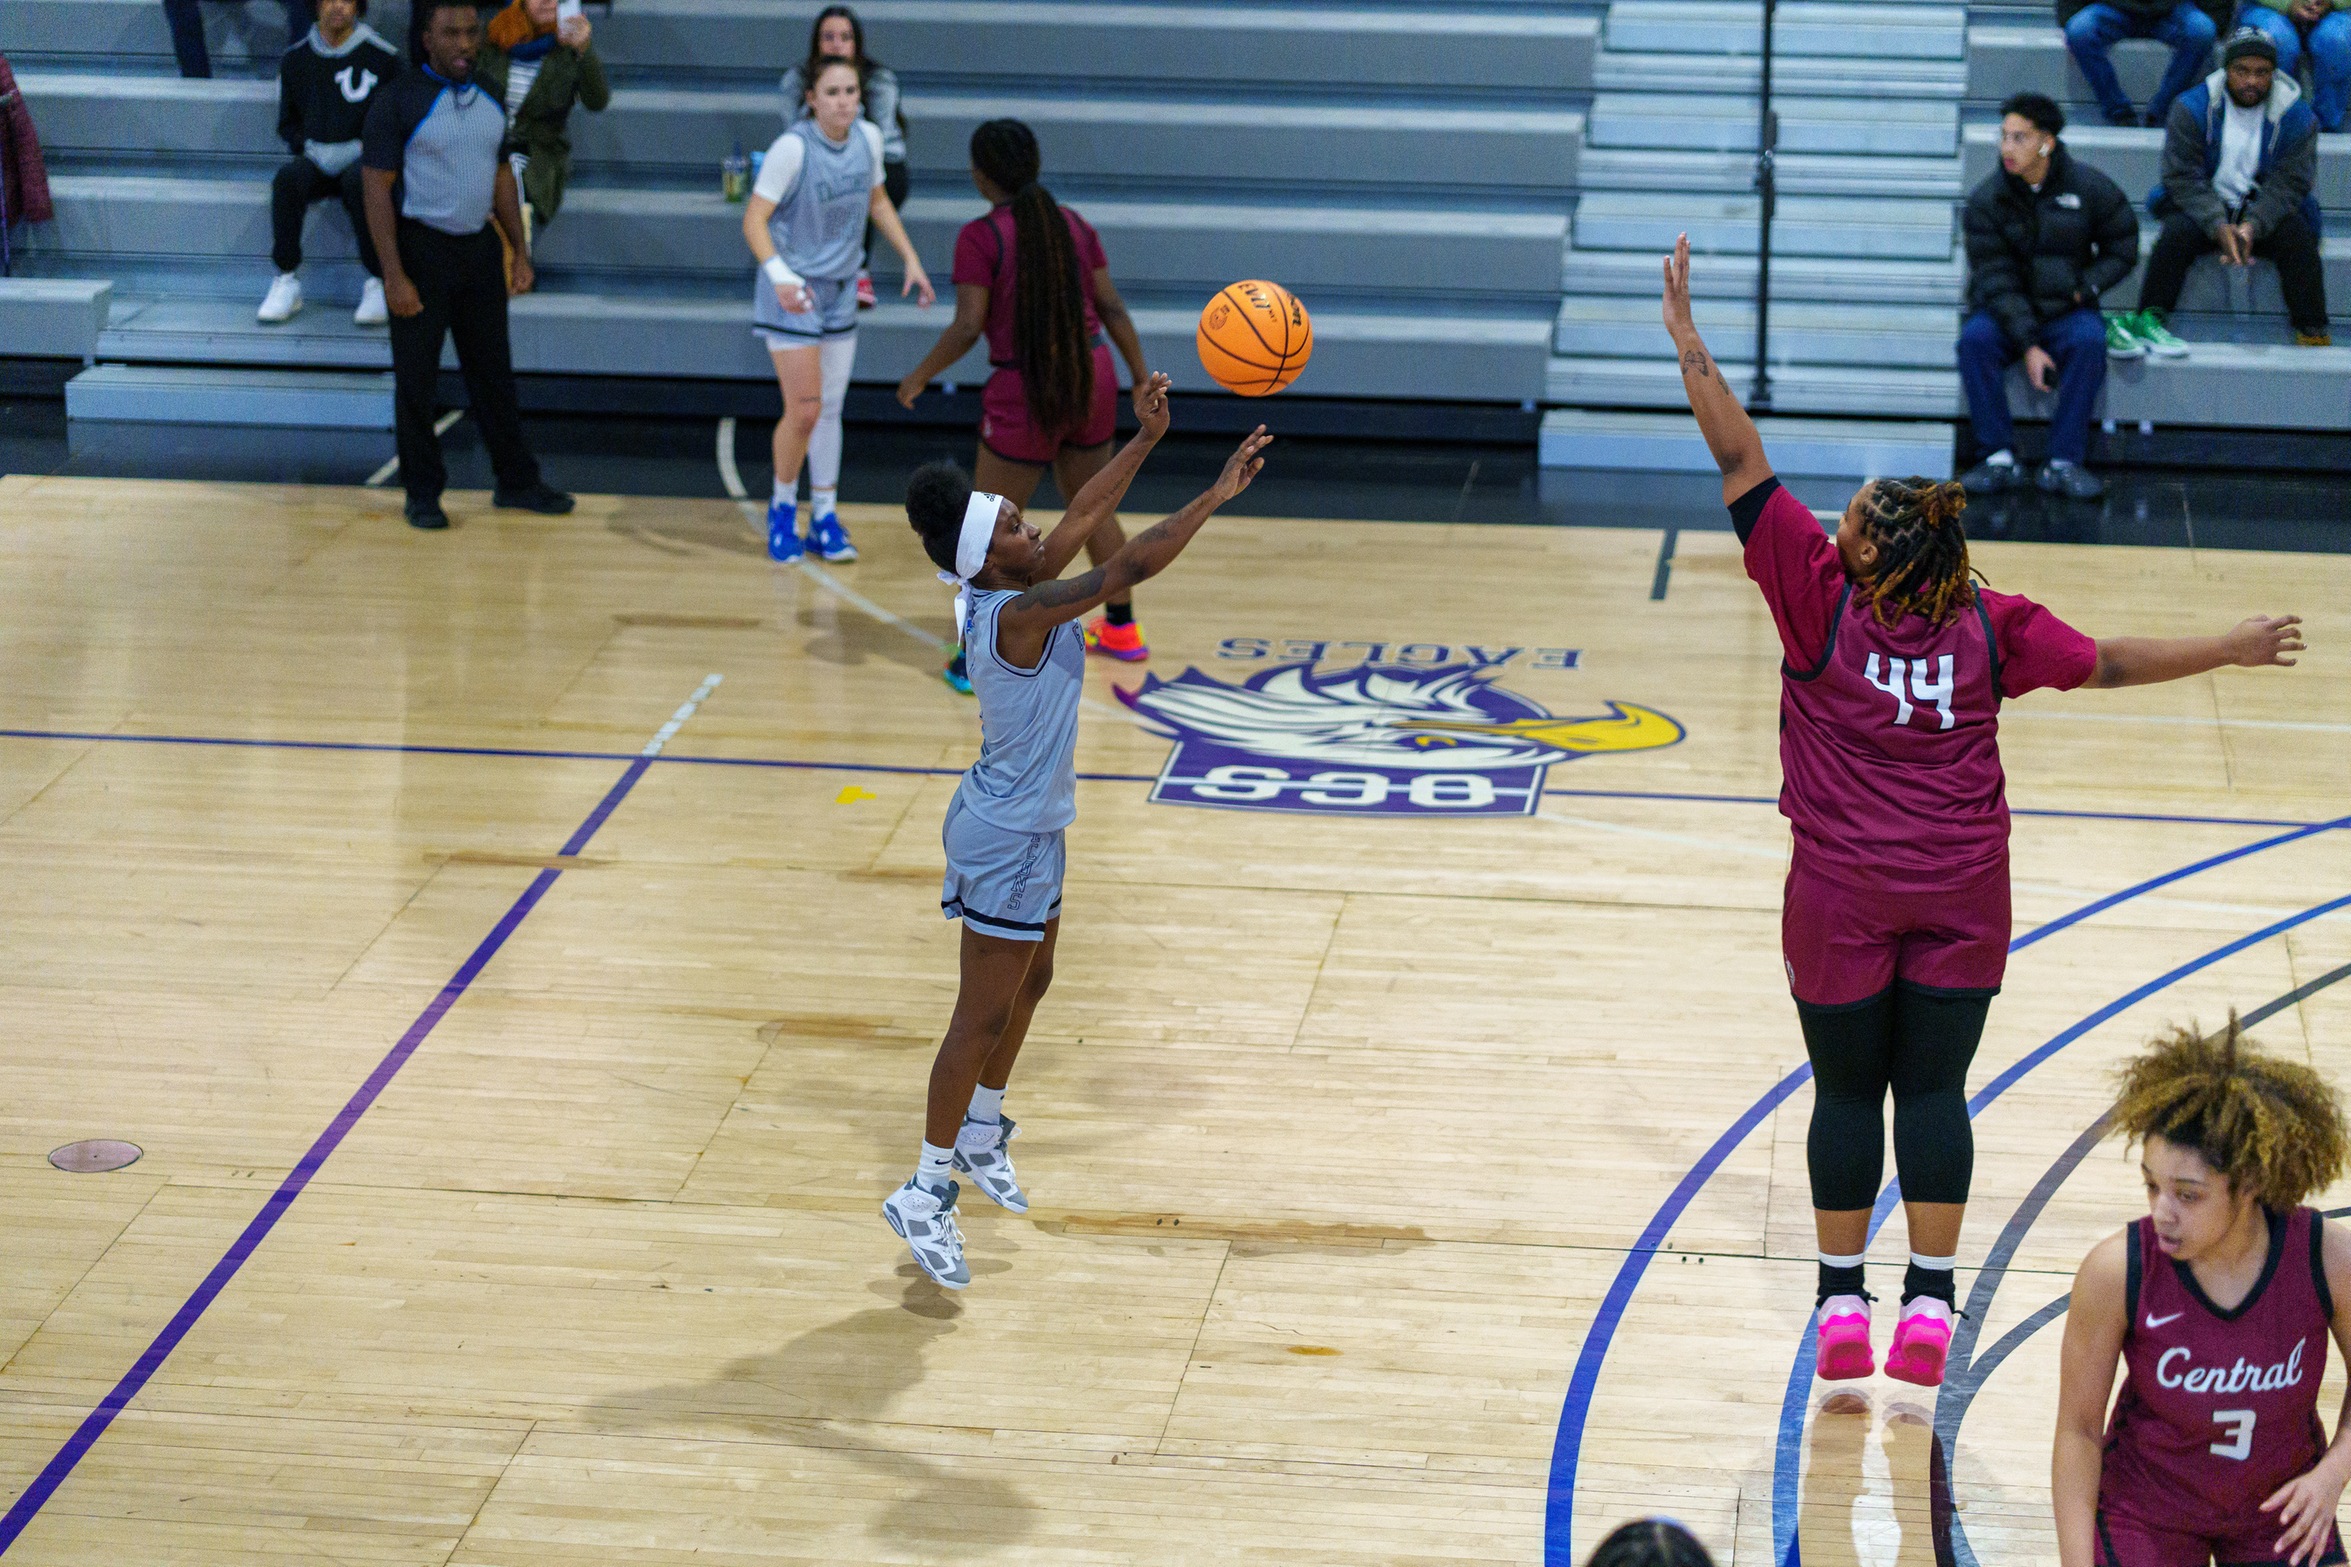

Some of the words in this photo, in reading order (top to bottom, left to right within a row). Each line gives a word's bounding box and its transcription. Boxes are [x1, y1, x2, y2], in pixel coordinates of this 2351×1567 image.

[1215, 637, 1584, 671] EAGLES
[1863, 651, 1956, 730] 44
[1191, 764, 1497, 808] OCS
[1007, 832, 1041, 911] LCONS
[2156, 1336, 2307, 1394] Central
[2209, 1409, 2258, 1461] 3
